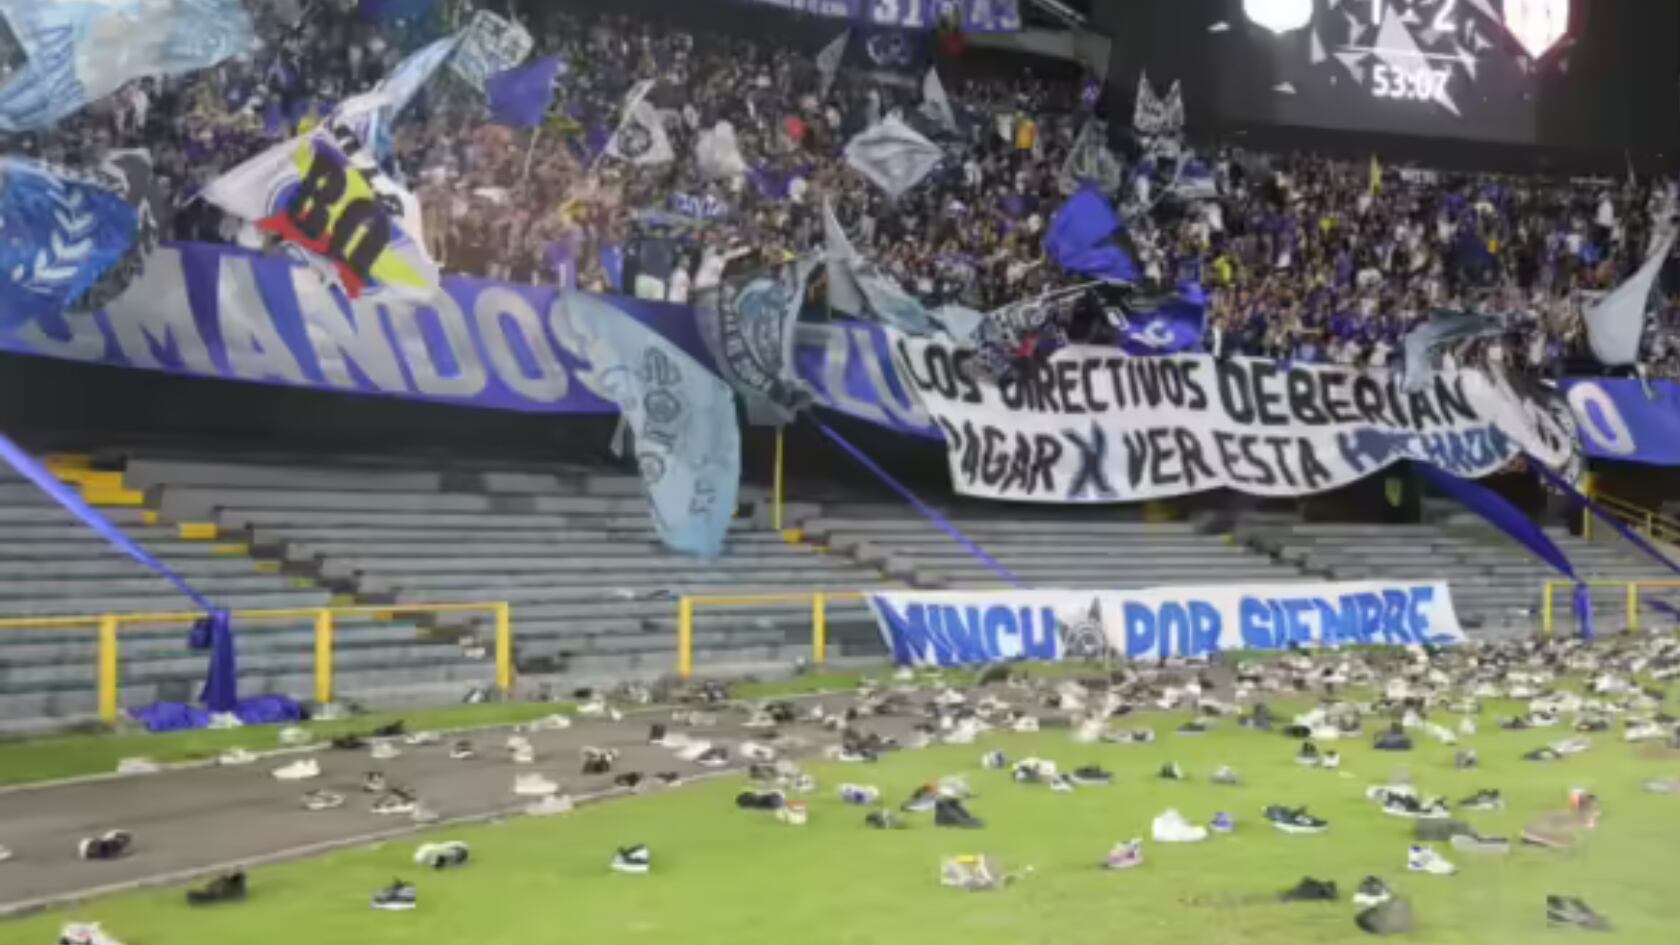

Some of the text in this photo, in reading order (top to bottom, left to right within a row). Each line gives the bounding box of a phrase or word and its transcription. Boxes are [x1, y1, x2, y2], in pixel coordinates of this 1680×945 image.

[1371, 64, 1452, 100] 53:07
[897, 338, 981, 403] LOS
[1060, 420, 1118, 499] X
[1122, 425, 1216, 489] VER
[1213, 430, 1330, 489] ESTA
